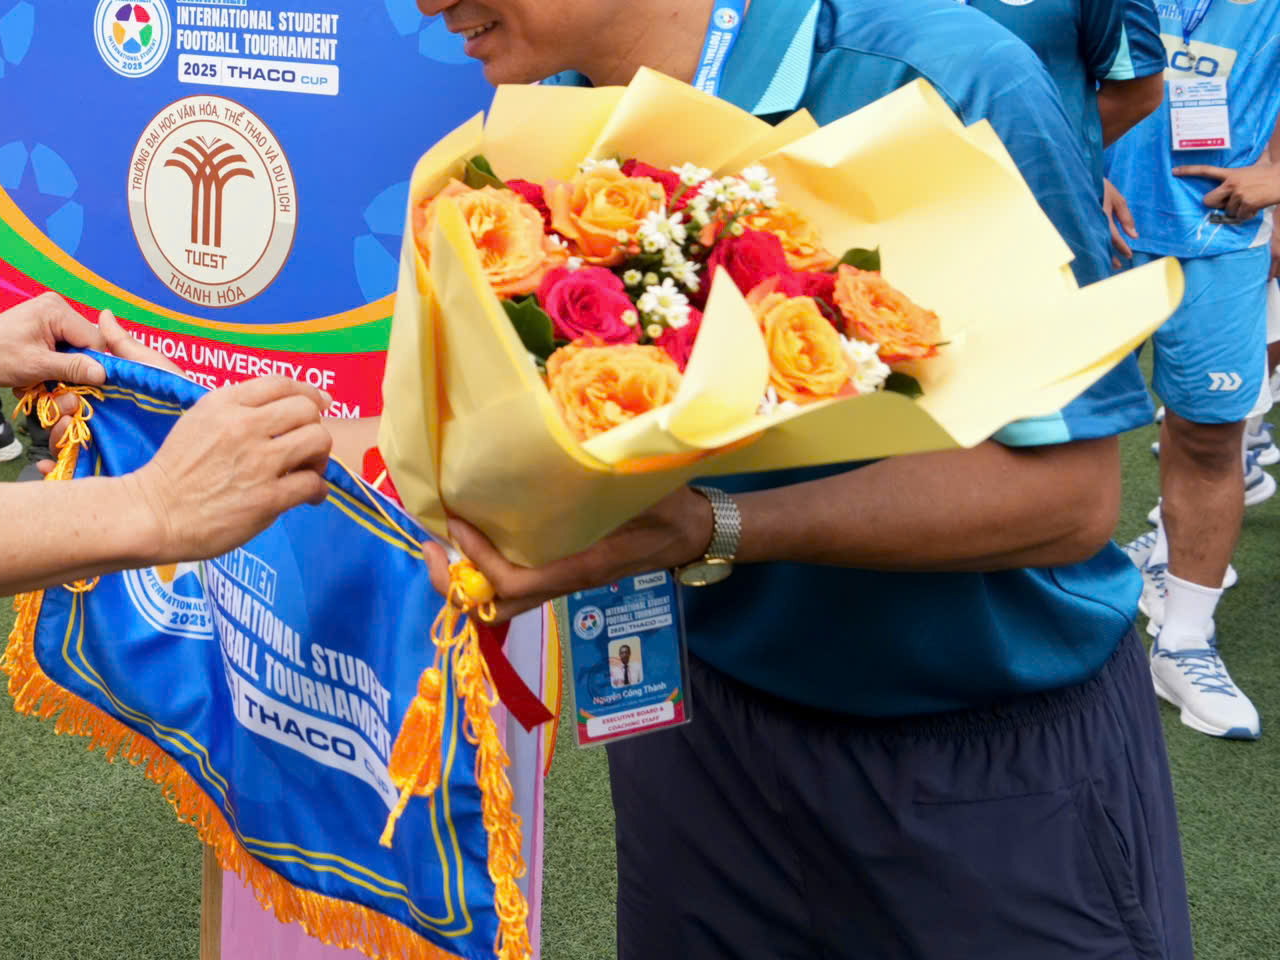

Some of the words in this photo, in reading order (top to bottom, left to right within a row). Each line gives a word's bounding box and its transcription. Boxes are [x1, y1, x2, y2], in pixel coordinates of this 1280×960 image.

[176, 6, 274, 31] INTERNATIONAL
[278, 11, 339, 34] STUDENT
[108, 35, 139, 62] INTERNATIONAL
[140, 38, 157, 59] STUDENT
[176, 29, 239, 54] FOOTBALL
[243, 33, 338, 60] TOURNAMENT
[122, 62, 143, 70] 2025
[183, 62, 217, 77] 2025
[227, 65, 296, 83] THACO
[300, 75, 328, 86] CUP
[158, 113, 178, 134] HỌC
[176, 103, 197, 121] VĂN
[145, 131, 162, 152] ĐẠI
[246, 119, 268, 149] THAO
[264, 146, 280, 165] VÀ
[271, 164, 287, 183] DU
[276, 185, 292, 214] LỊCH
[184, 248, 228, 271] TUCST
[169, 271, 212, 305] THANH
[217, 284, 247, 305] HÓA
[150, 335, 189, 363] HOA
[191, 346, 303, 382] UNIVERSITY
[305, 367, 336, 391] OF
[244, 693, 357, 762] THACO
